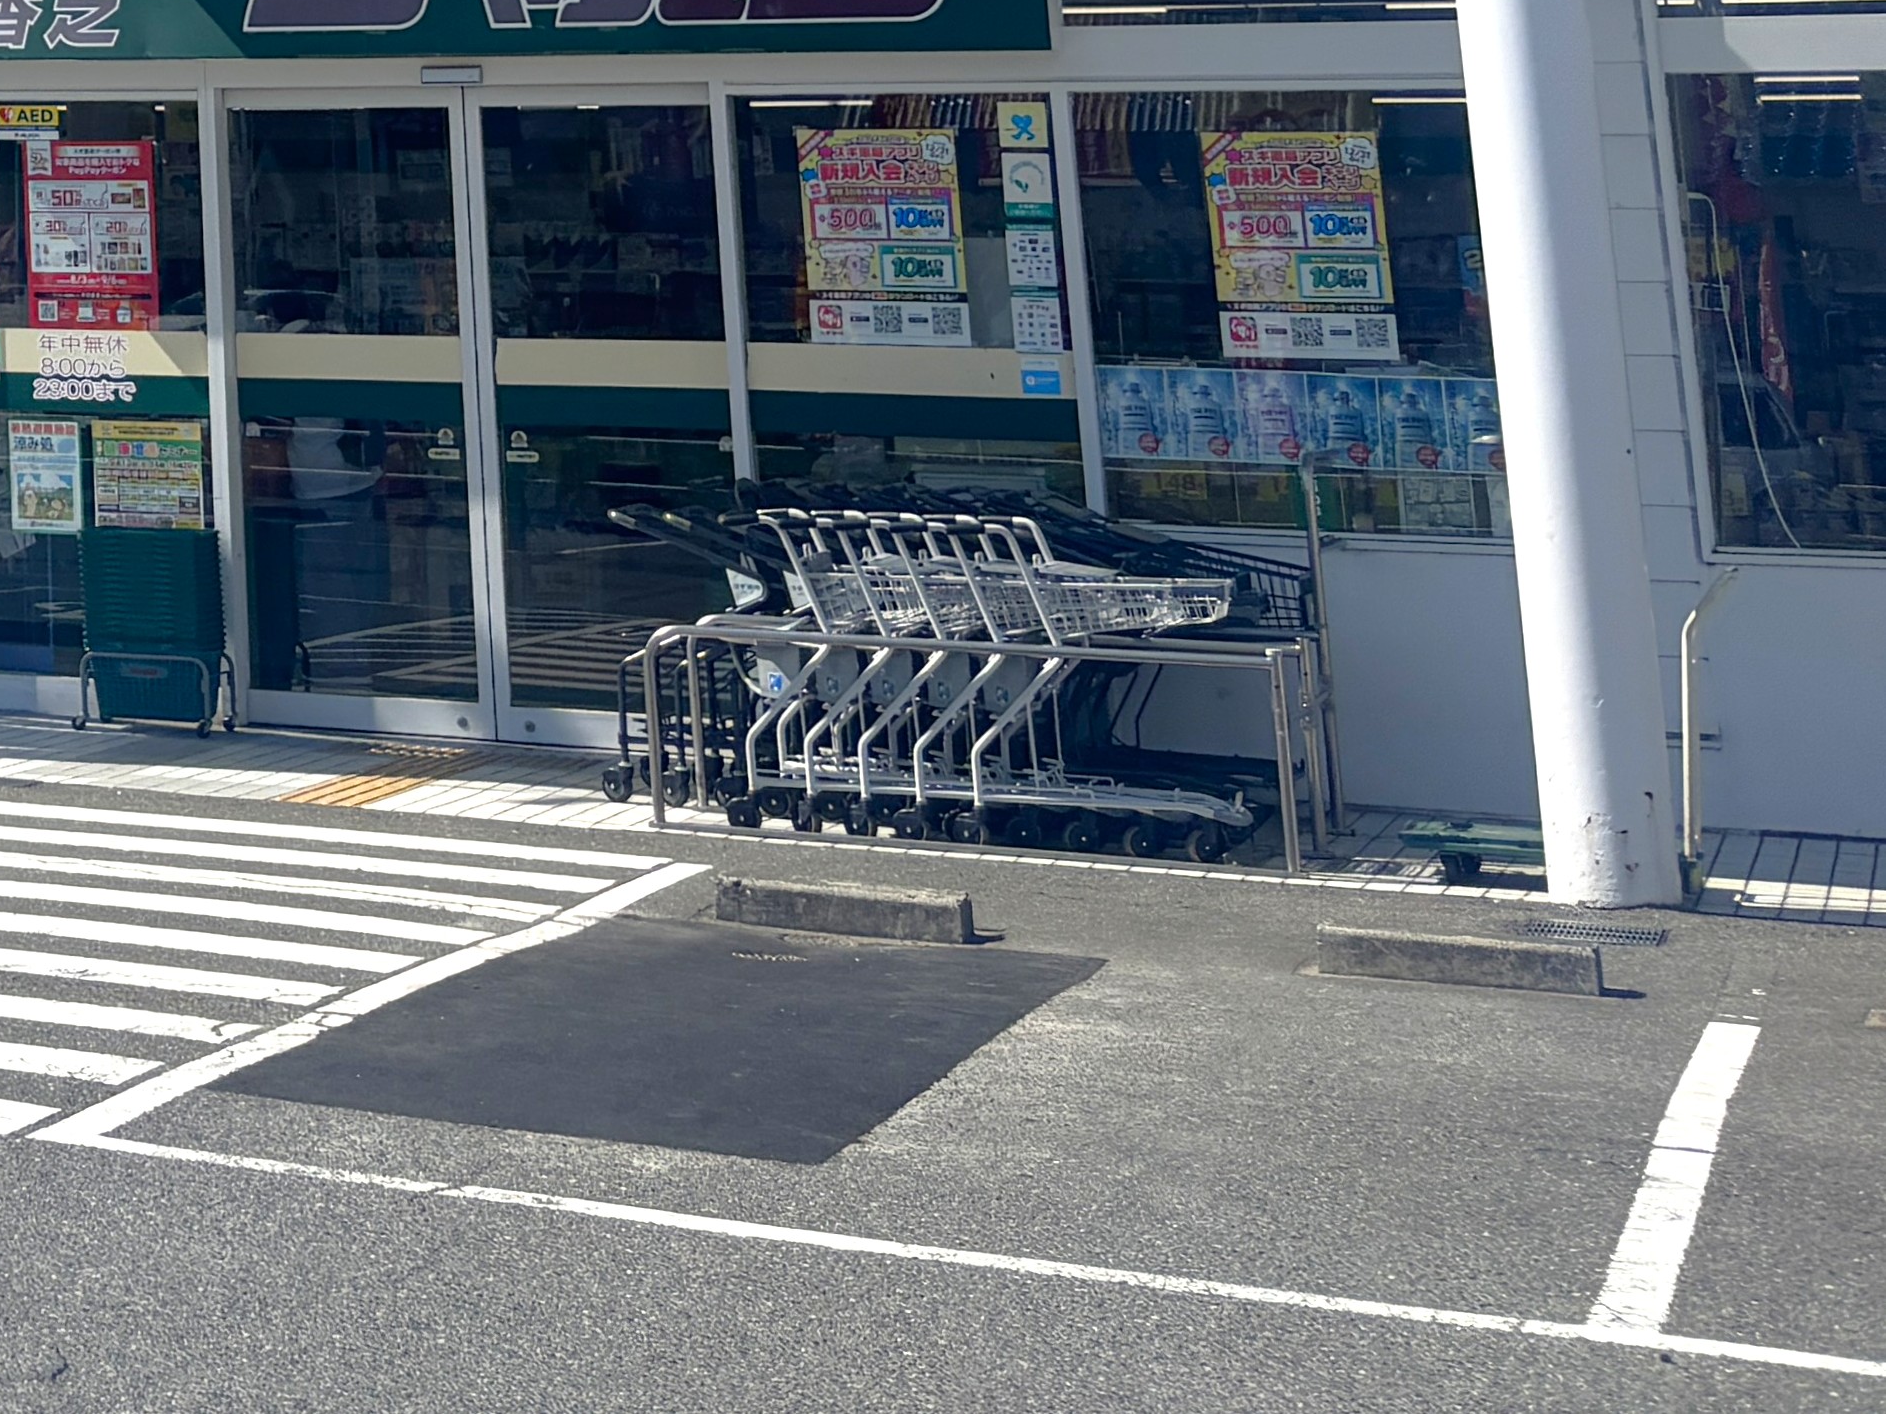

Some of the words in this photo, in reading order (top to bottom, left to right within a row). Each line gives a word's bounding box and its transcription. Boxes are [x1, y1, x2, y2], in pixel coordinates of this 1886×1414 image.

[16, 108, 53, 122] AED
[39, 334, 128, 353] 年中無休
[41, 357, 126, 376] 8:00から
[33, 378, 137, 402] 23:00まで
